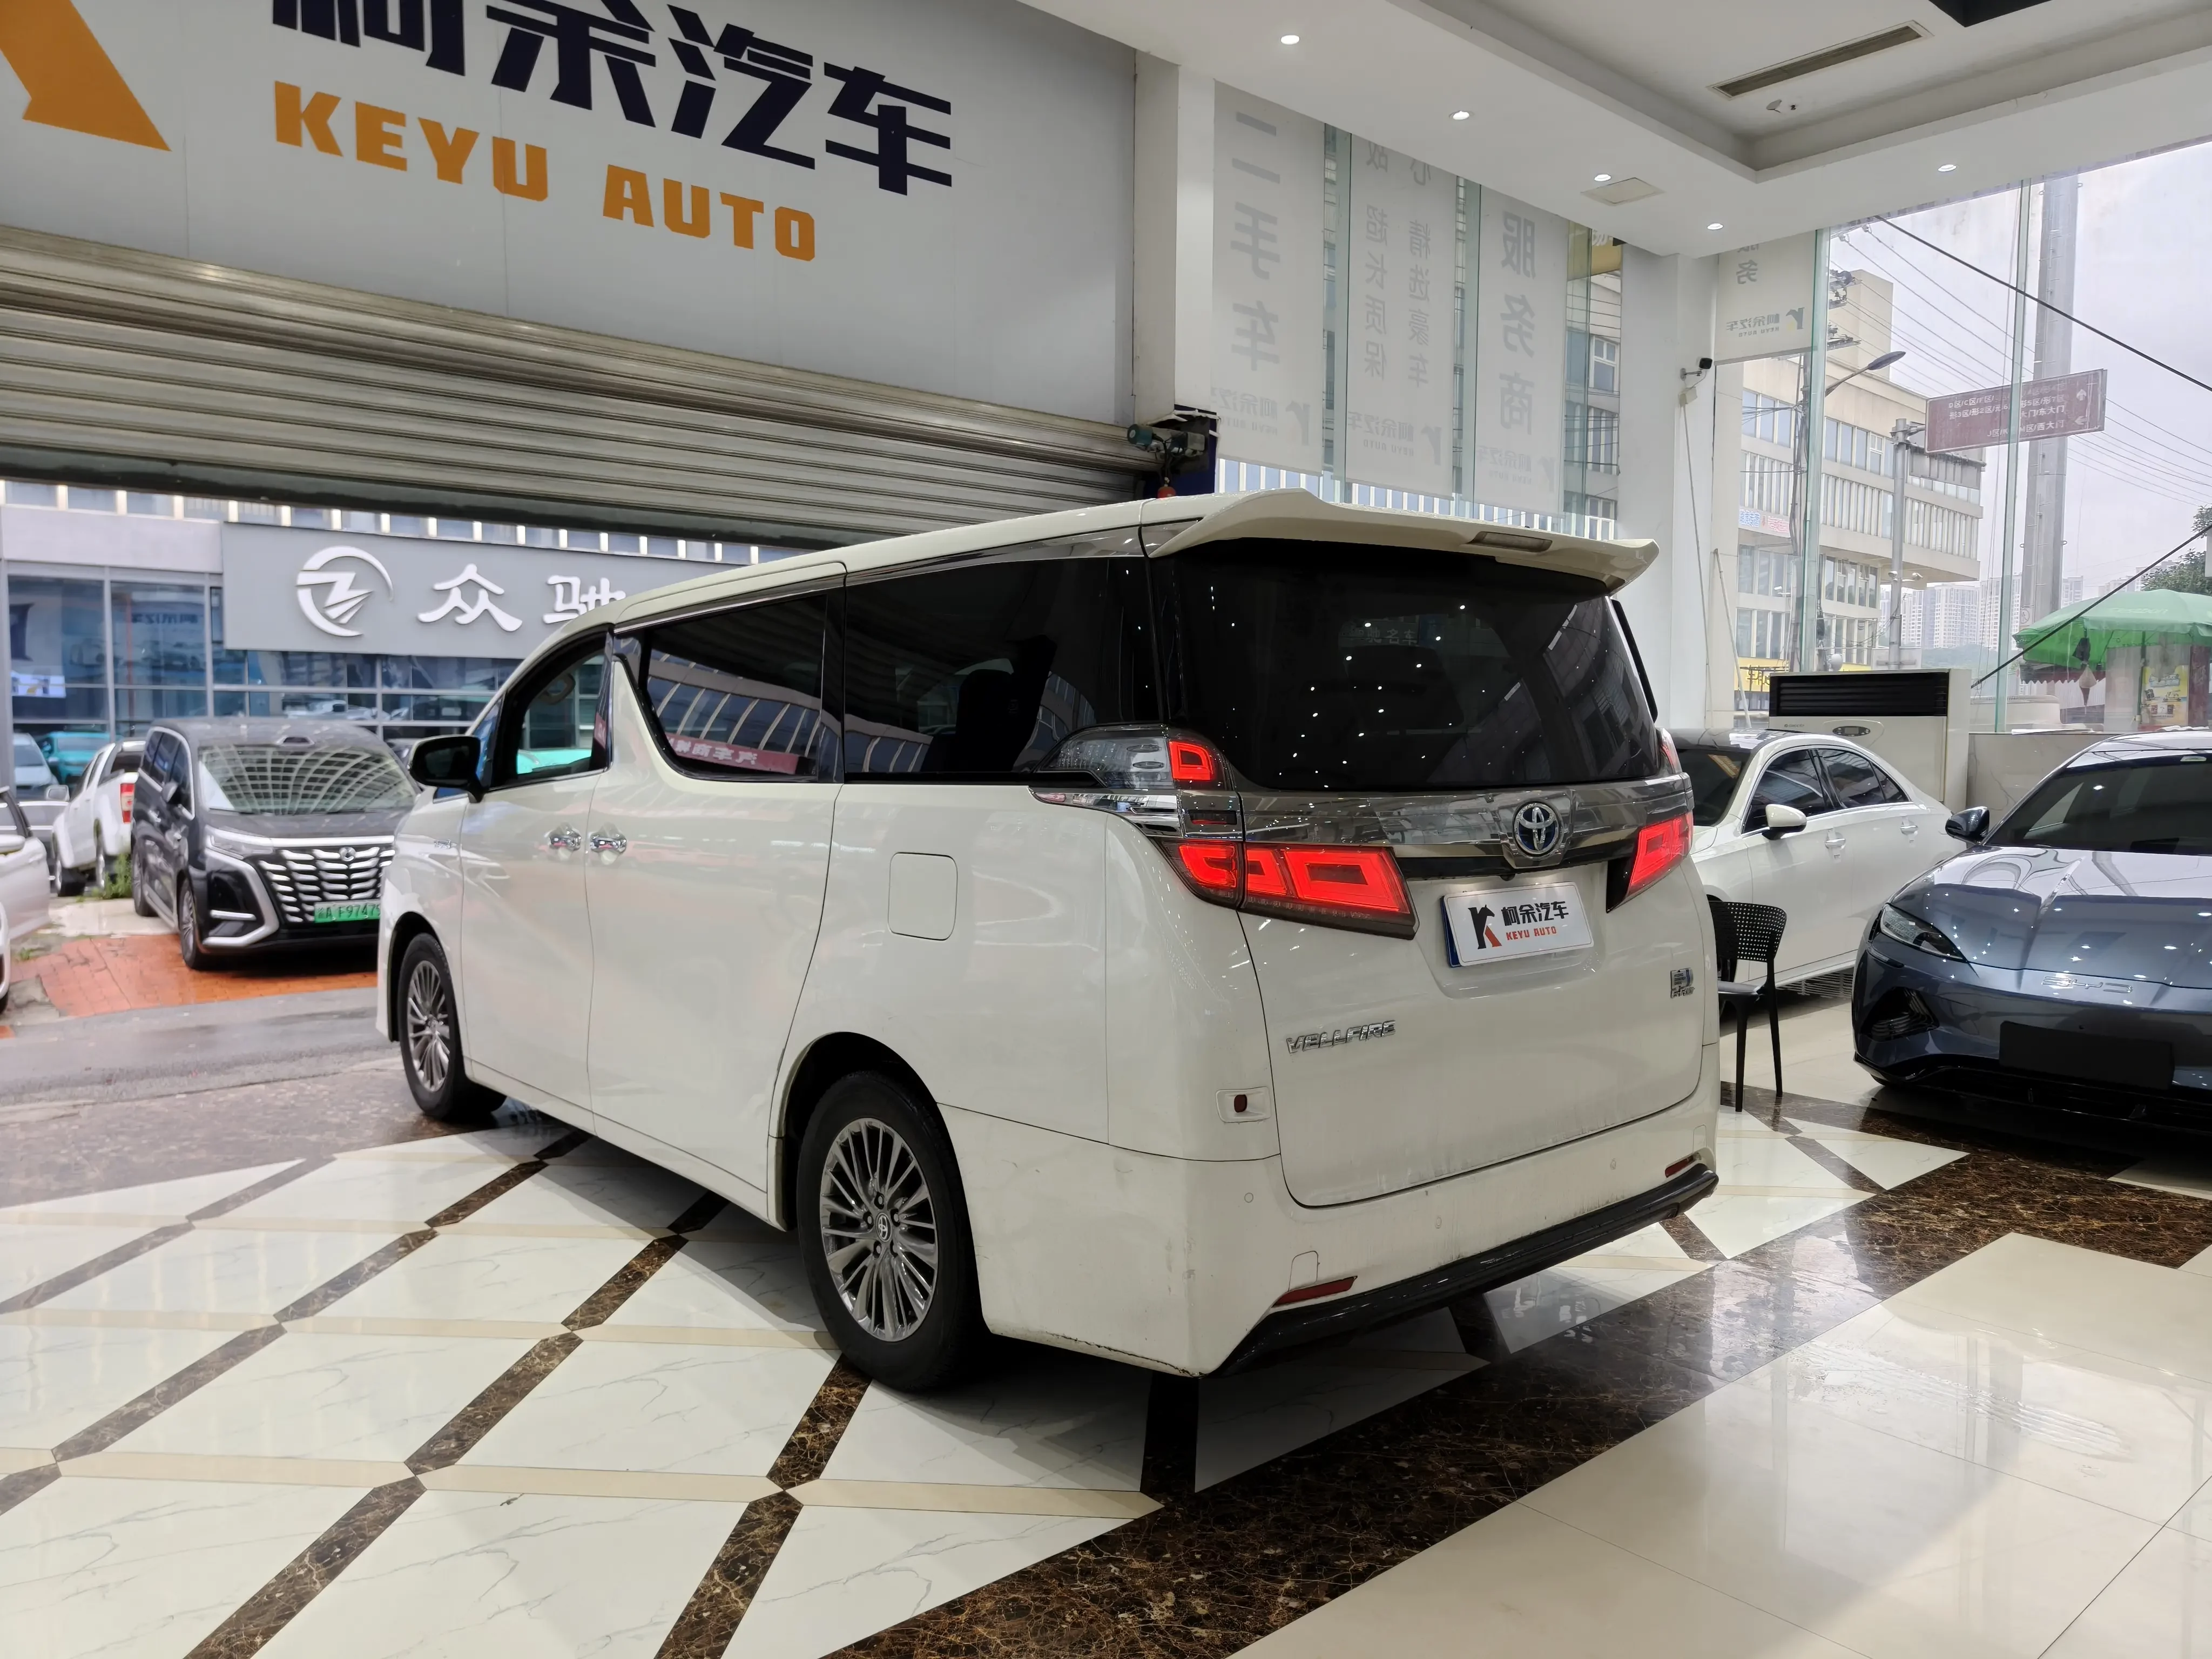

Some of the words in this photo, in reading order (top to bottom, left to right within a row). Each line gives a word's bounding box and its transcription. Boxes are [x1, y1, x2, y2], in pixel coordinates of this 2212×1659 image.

[274, 80, 548, 201] KEYU
[602, 164, 815, 261] AUTO
[1501, 901, 1569, 926] 柯余汽车
[1506, 930, 1530, 941] KEYU
[1534, 926, 1557, 937] AUTO
[2041, 976, 2134, 994] BYD
[1286, 1019, 1397, 1054] VELLFIRE
